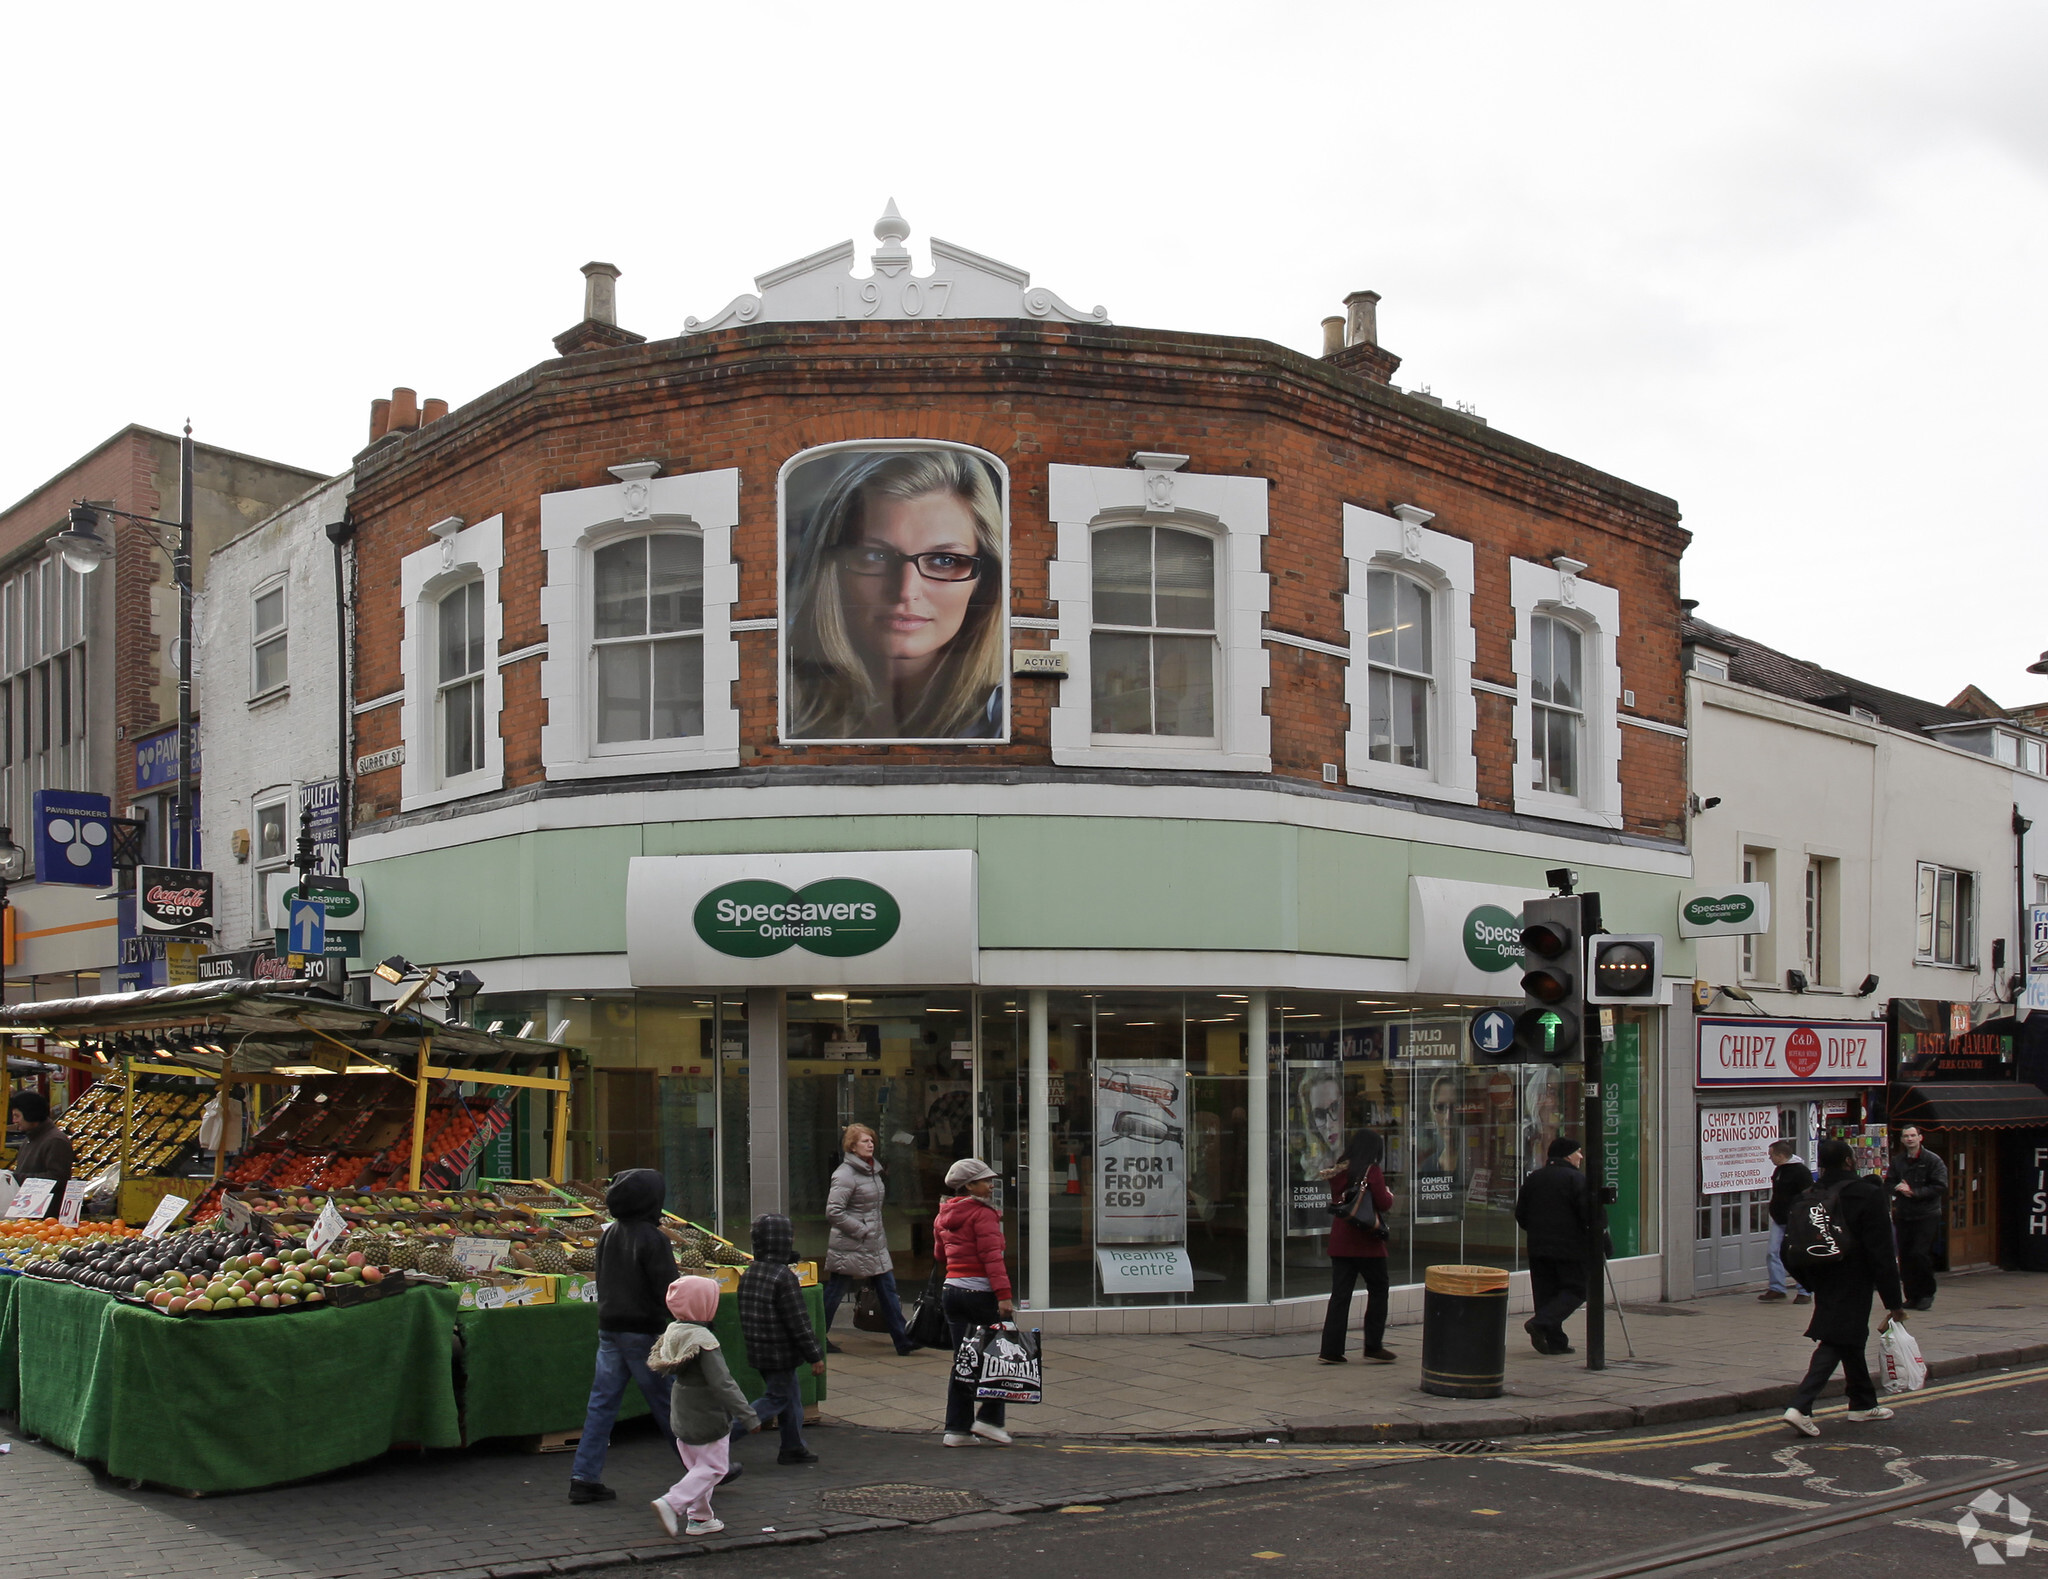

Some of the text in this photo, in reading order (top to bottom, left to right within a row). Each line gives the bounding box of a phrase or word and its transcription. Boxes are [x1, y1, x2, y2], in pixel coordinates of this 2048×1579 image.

[836, 279, 953, 319] 1907
[1024, 658, 1061, 667] ACTIVE
[359, 750, 401, 773] SURREY ST
[45, 806, 108, 818] PAWNBROKERS
[310, 843, 340, 876] EWS
[147, 885, 207, 908] Coca-Cola
[157, 903, 194, 917] zero
[716, 898, 877, 926] Specsavers
[1691, 902, 1747, 914] Specsavers
[759, 923, 832, 940] Opticians
[1497, 943, 1526, 958] Opticia
[200, 959, 233, 978] TULLETTS
[304, 960, 325, 978] ero
[1954, 1015, 1966, 1029] TJ
[1719, 1034, 1868, 1069] CHIPZ DIPZ
[1916, 1032, 2000, 1055] TASTE OF JAMAICA
[1938, 1060, 1983, 1069] JERK CENTRE
[1708, 1111, 1771, 1127] CHIPZ N DIPZ
[1603, 1082, 1619, 1198] ontact Lenses
[1702, 1125, 1778, 1143] OPENING SOON
[1104, 1156, 1174, 1173] 2 FOR 1
[1104, 1174, 1164, 1190] FROM
[1720, 1168, 1761, 1180] STAFF REQUIRED
[1300, 1186, 1315, 1194] FOR
[1421, 1184, 1450, 1192] GLASSES
[1703, 1180, 1720, 1189] PLEASE
[1720, 1180, 1735, 1188] APPLY
[2028, 1148, 2048, 1235] FISH
[1104, 1191, 1146, 1208] £69
[1293, 1193, 1327, 1201] DESIGNER
[1294, 1200, 1327, 1209] FROM £99
[1110, 1250, 1178, 1263] hearing
[1120, 1261, 1175, 1277] centre
[478, 1290, 499, 1304] QUEEN
[980, 1352, 1041, 1388] LONSDALE
[1001, 1381, 1024, 1389] LONDON
